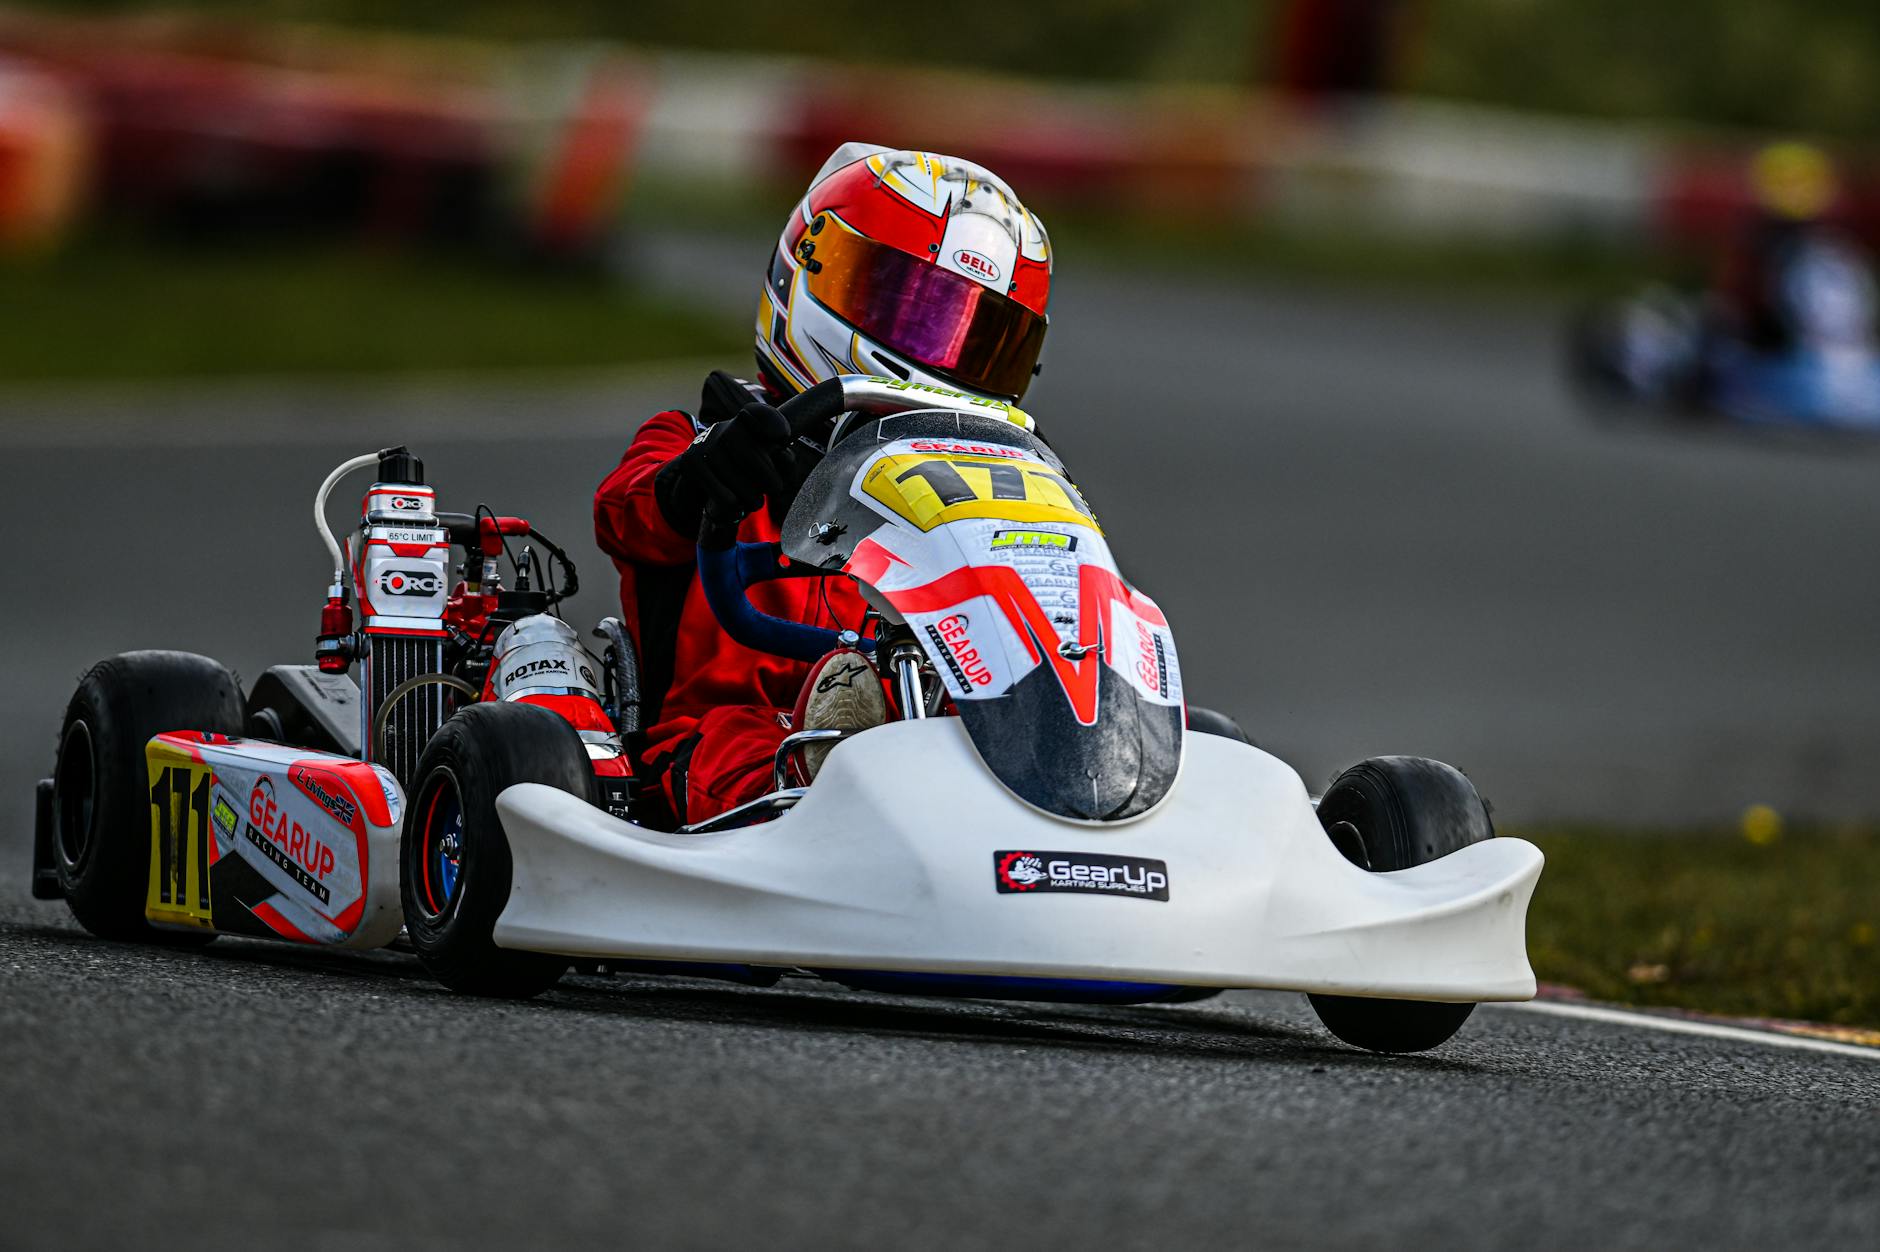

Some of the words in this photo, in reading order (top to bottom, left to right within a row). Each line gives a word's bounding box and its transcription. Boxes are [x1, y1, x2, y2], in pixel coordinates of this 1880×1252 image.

[960, 252, 995, 277] BELL
[911, 442, 1023, 457] GEARUP
[389, 532, 409, 541] 65°C
[411, 533, 434, 542] LIMIT
[378, 571, 444, 595] FORCE
[927, 627, 951, 660] RACING
[952, 665, 970, 690] TEAM
[938, 616, 992, 685] GEARUP
[1136, 621, 1158, 690] GEARUP
[505, 659, 567, 687] ROTAX
[297, 768, 304, 784] L
[250, 787, 335, 880] GEARUP
[249, 829, 288, 869] RACING
[296, 869, 326, 899] TEAM
[1048, 861, 1166, 892] GearUp
[1051, 880, 1095, 888] KARTING
[1098, 881, 1146, 893] SUPPLIES
